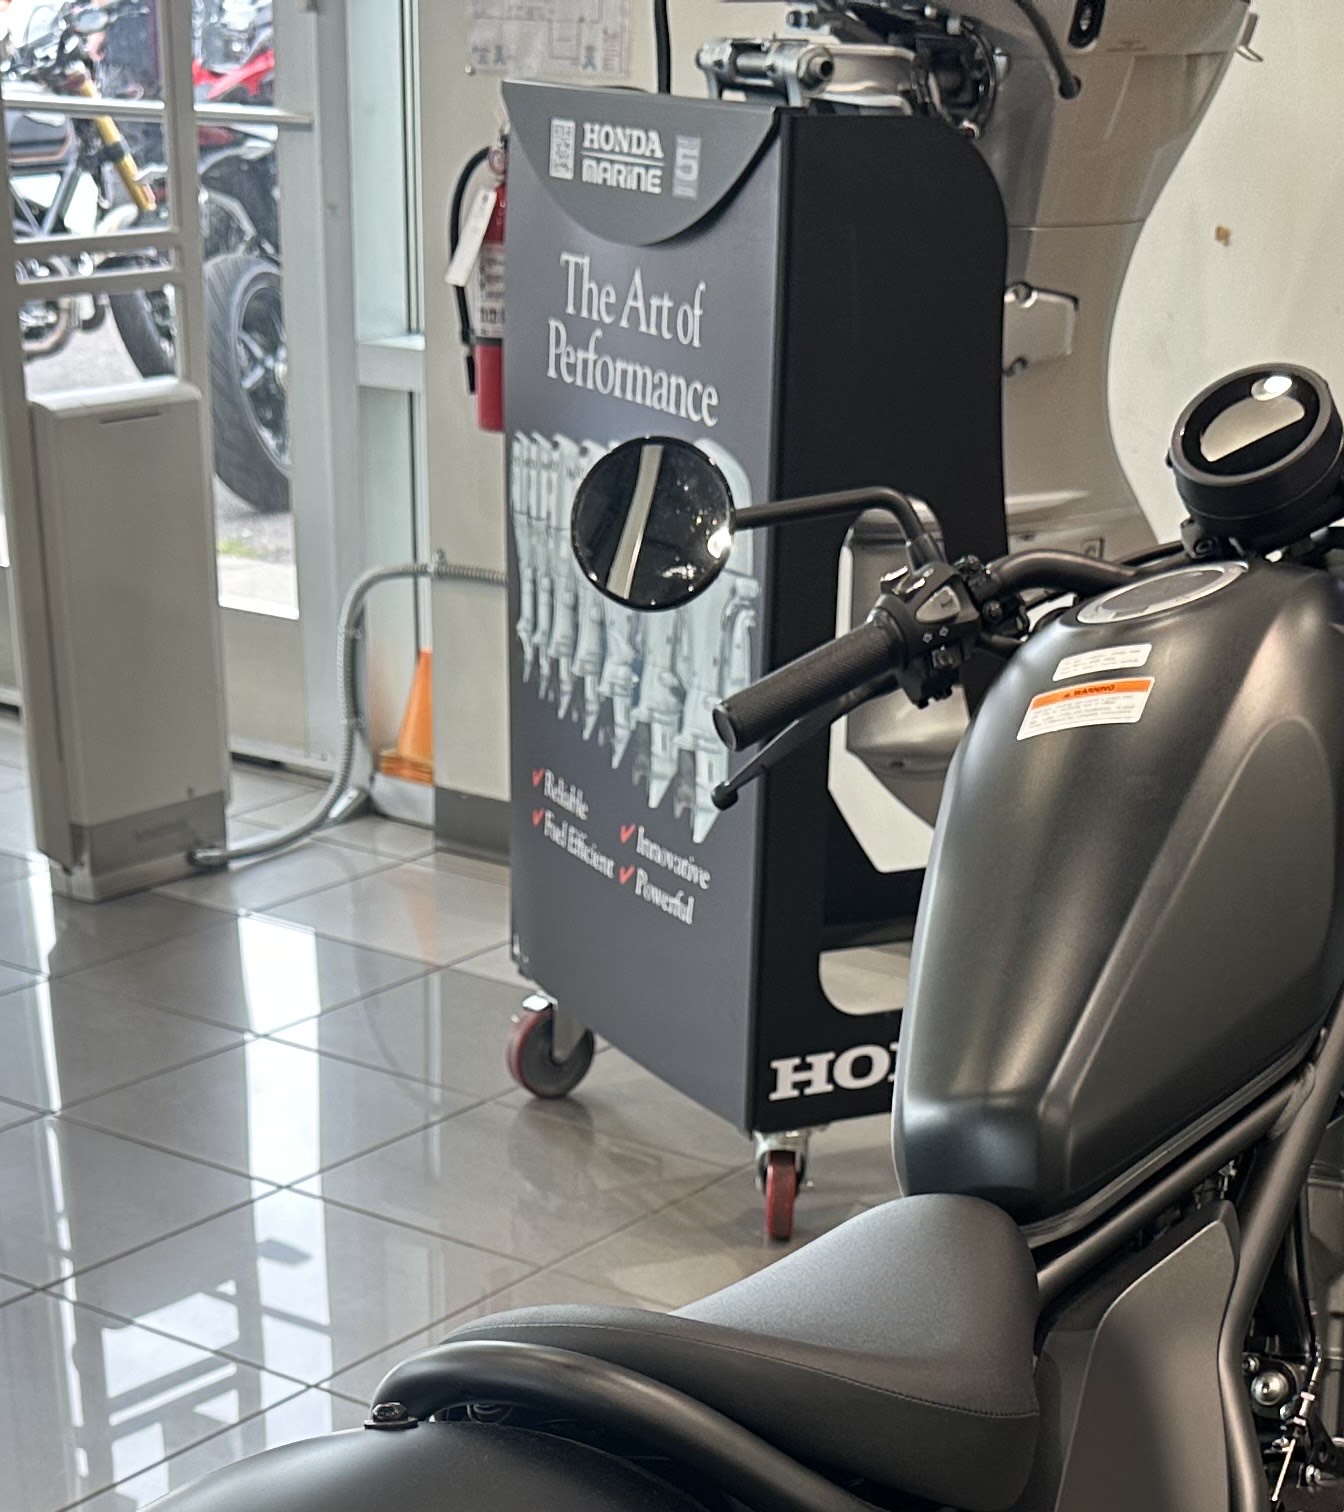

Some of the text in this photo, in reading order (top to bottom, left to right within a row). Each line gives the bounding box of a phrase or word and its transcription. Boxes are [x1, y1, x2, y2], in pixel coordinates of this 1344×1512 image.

[582, 122, 665, 158] HONDA
[582, 158, 663, 195] MARINE
[560, 252, 617, 324] The
[619, 266, 674, 340] Art
[676, 280, 706, 348] of
[547, 317, 719, 428] Performance
[543, 769, 589, 821] Reliable
[543, 809, 615, 879] Fuel Efficient
[636, 825, 711, 890] Innovative
[634, 867, 694, 925] Powerful
[768, 1041, 898, 1101] HO
